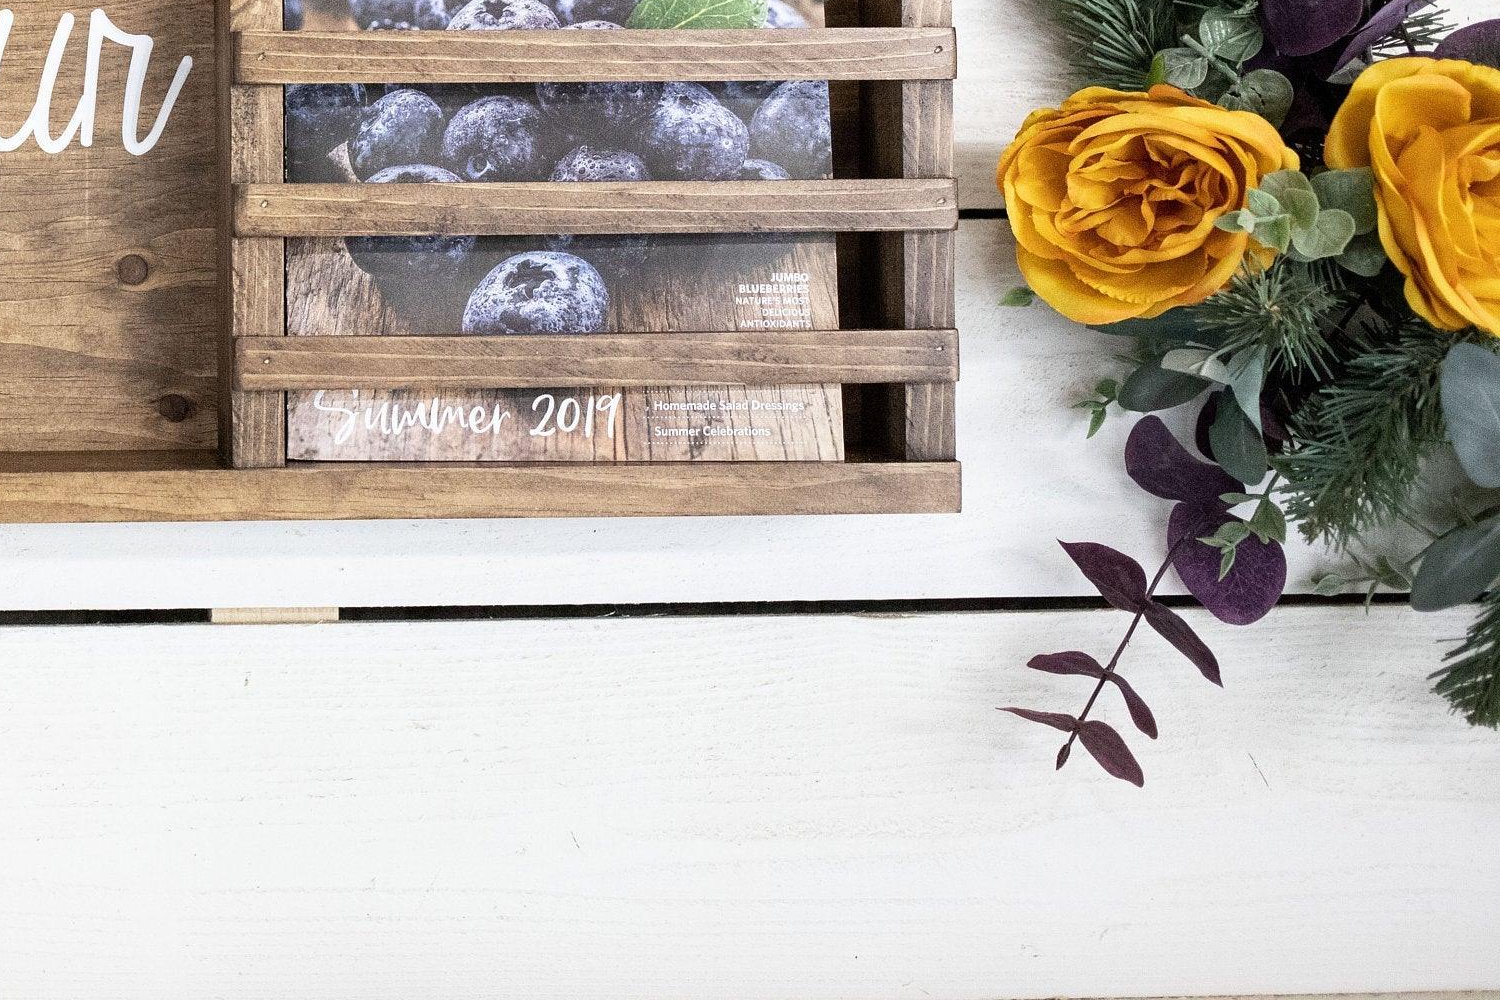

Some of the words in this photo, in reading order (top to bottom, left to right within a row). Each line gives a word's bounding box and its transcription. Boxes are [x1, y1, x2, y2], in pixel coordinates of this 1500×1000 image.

[770, 272, 809, 282] JUMBO
[739, 283, 810, 294] BLUEBERRIES
[735, 296, 780, 305] NATURE'S
[782, 296, 810, 305] MOST
[762, 308, 811, 317] DELICIOUS
[739, 319, 811, 328] ANTIOXIDANTS
[653, 400, 717, 411] Homemade
[718, 400, 749, 411] Salad
[751, 400, 805, 414] Dressings
[313, 389, 511, 445] Summer
[529, 393, 622, 439] 2019
[654, 426, 700, 437] Summer
[703, 426, 772, 437] Celebrations
